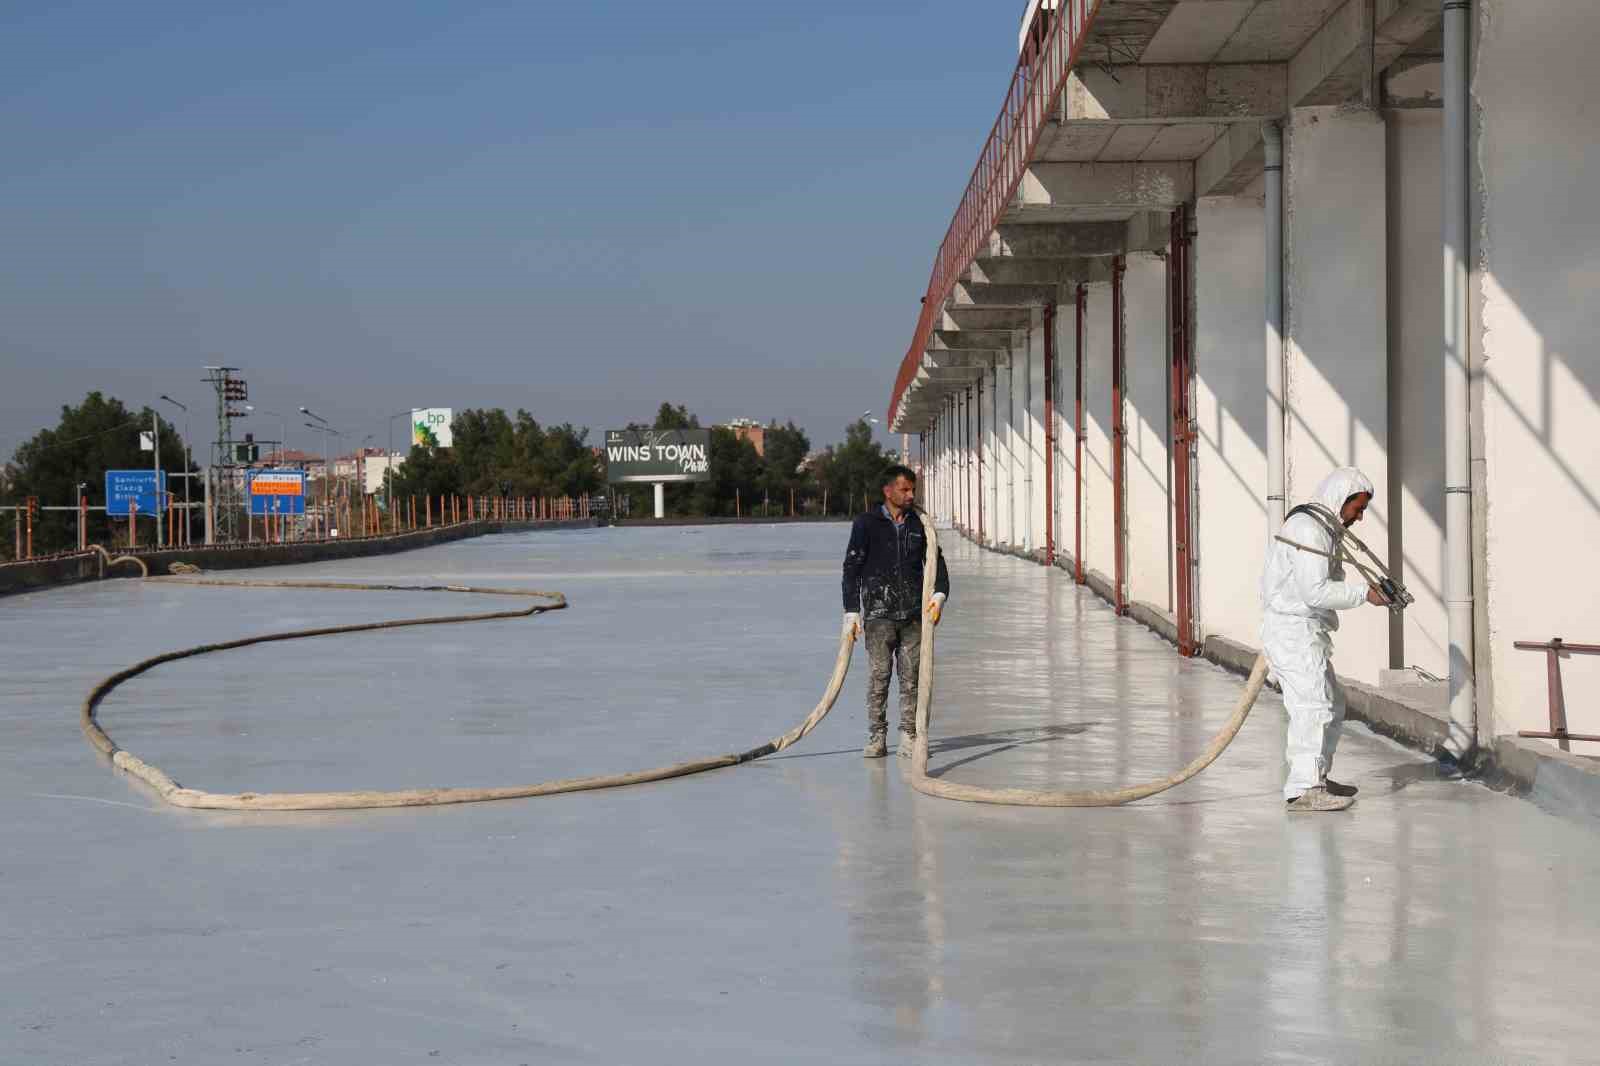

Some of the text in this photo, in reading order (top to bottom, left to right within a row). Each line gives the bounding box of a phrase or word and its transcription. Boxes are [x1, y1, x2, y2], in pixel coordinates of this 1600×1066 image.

[427, 411, 445, 427] bp
[607, 444, 704, 462] WINS TOWN
[680, 456, 709, 473] Park
